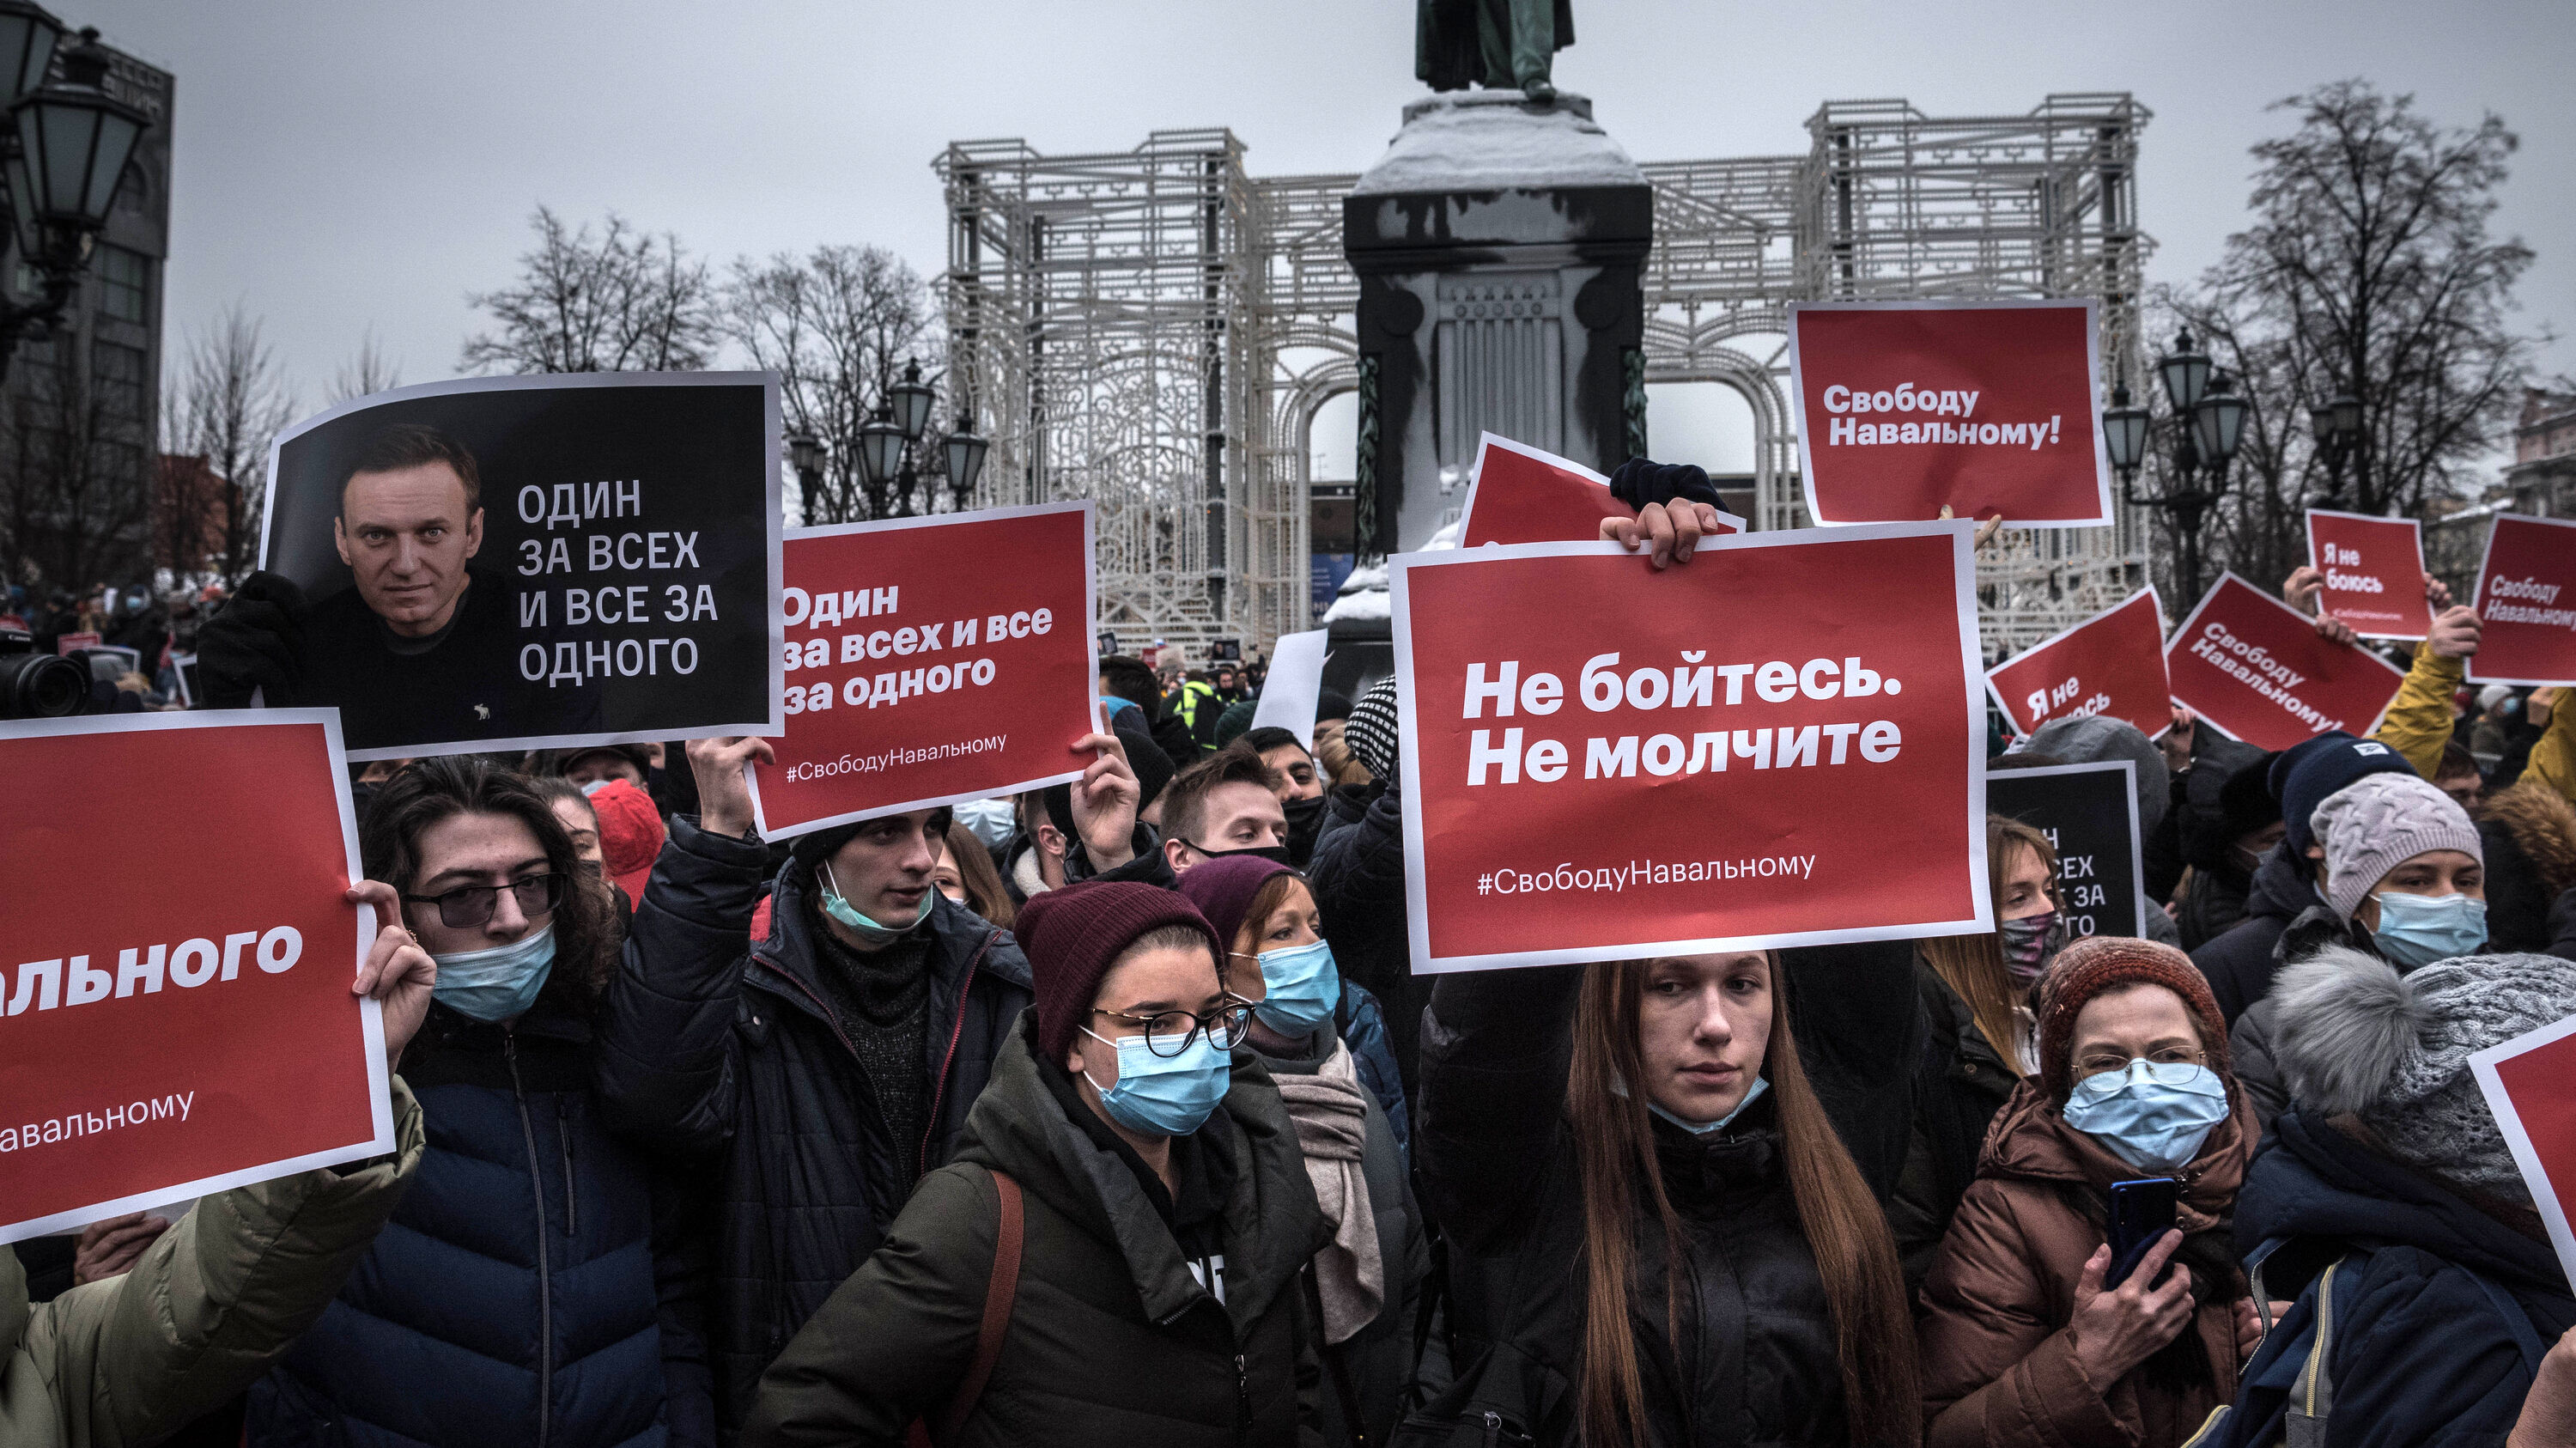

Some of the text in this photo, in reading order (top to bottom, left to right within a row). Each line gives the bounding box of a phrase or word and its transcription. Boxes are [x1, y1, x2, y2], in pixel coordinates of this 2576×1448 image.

[1823, 382, 1979, 417] Свободу
[1829, 415, 2061, 450] Навальному!
[518, 479, 641, 530] ОДИН
[517, 531, 700, 576] ЗА ВСЕХ
[2324, 542, 2360, 567] Я не
[2326, 567, 2384, 593] боюсь
[2490, 574, 2561, 605] Свободу
[520, 584, 719, 628] И ВСЕ ЗА
[783, 585, 899, 630] Один
[519, 637, 699, 688] ОДНОГО
[783, 607, 1053, 672] за всех и все
[2203, 622, 2306, 689] Свободу
[783, 658, 996, 715] за одного
[1461, 650, 1902, 719] Не бойтесь.
[2026, 676, 2080, 722] Я не
[2190, 637, 2345, 733] Навальному!
[786, 733, 1007, 783] #СвободуНавальному
[1467, 719, 1901, 787] Не молчите
[1476, 855, 1816, 896] #СвободуНавальному
[2074, 884, 2106, 908] ЗА
[0, 925, 303, 1018] льного
